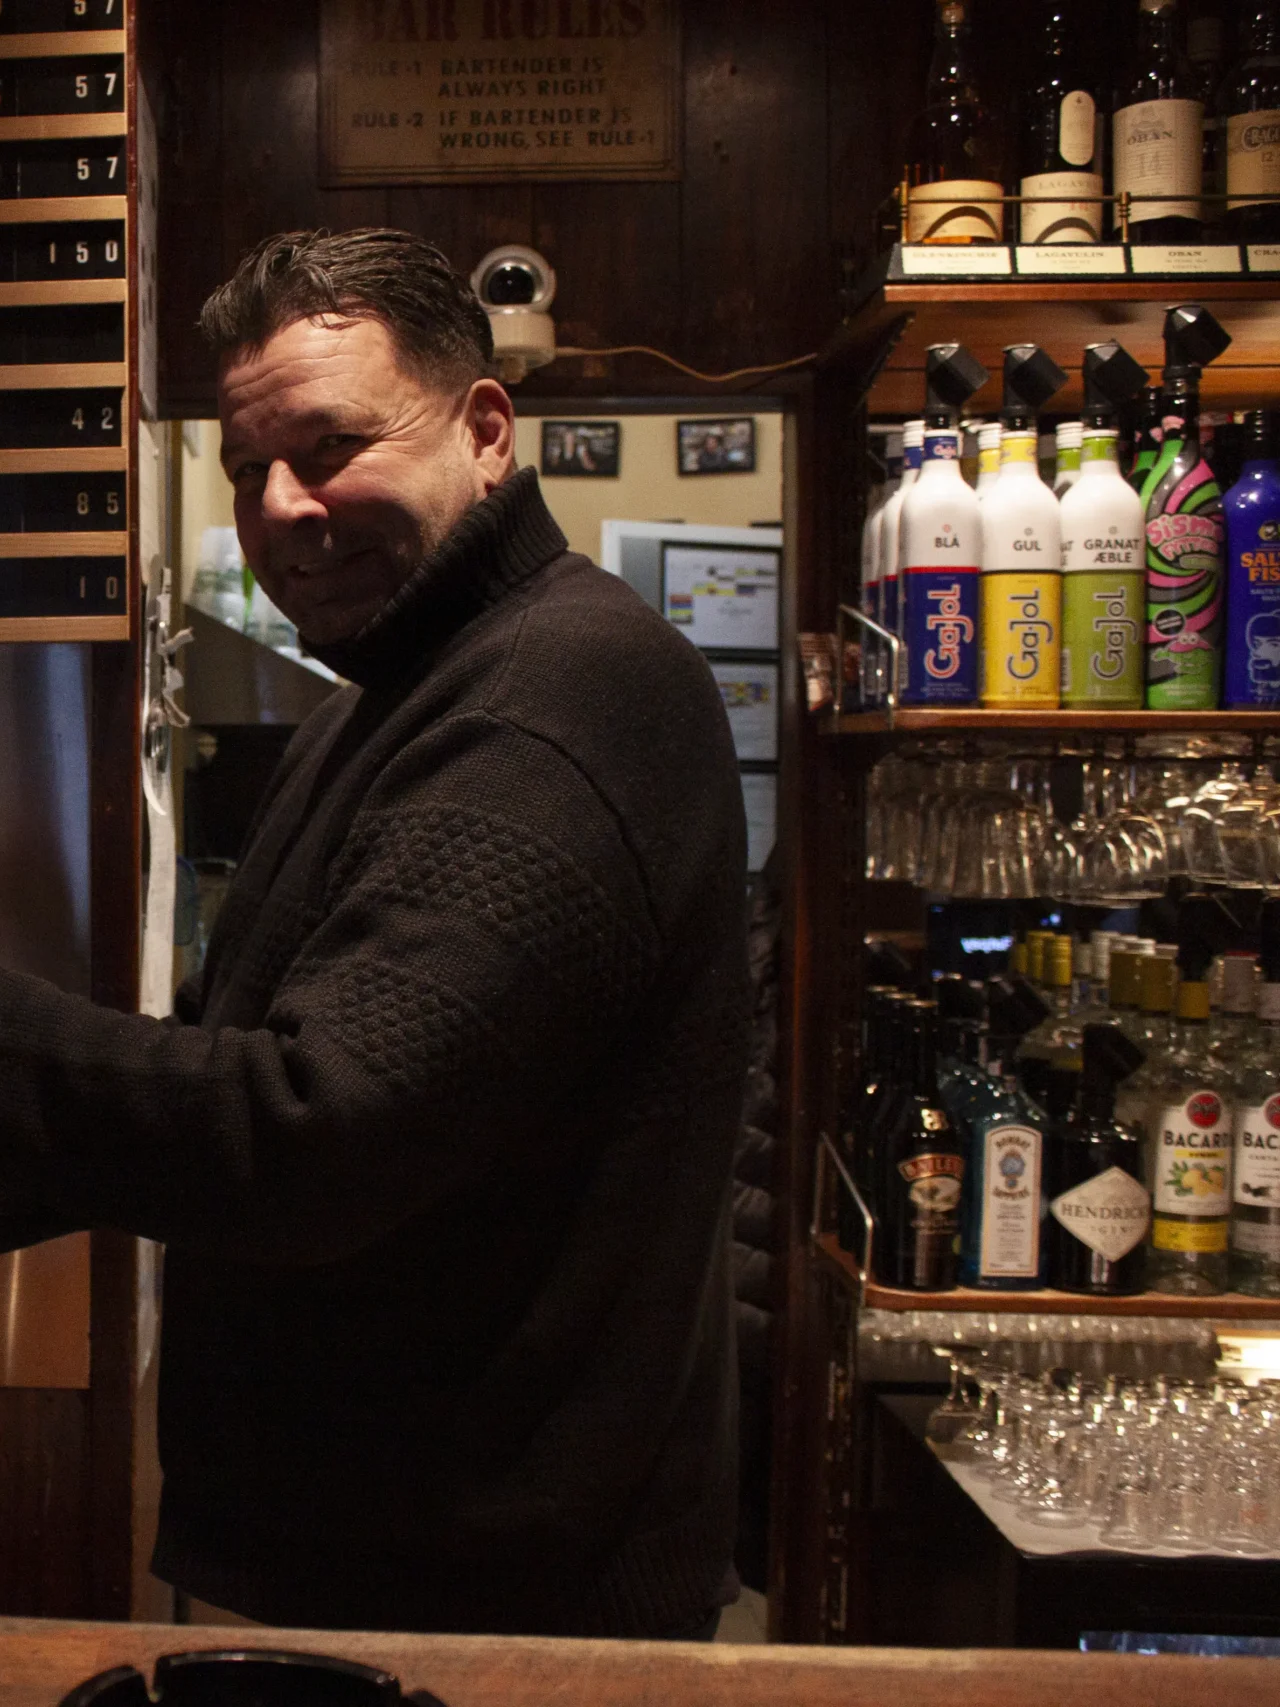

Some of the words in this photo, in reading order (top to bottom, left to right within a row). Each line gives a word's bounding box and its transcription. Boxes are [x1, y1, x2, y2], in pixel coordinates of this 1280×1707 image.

[441, 58, 572, 76] BARTENDER
[583, 57, 604, 73] IS
[438, 79, 527, 98] ALWAYS
[537, 78, 605, 95] RIGHT
[439, 110, 457, 126] IF
[470, 108, 601, 126] BARTENDER
[536, 131, 572, 147] SEE
[1127, 130, 1173, 146] OBAN
[1035, 251, 1105, 259] LAGAVULIN
[934, 534, 960, 548] BLÅ
[1013, 540, 1042, 551] GUL
[1084, 539, 1140, 550] GRANAT
[1093, 552, 1132, 563] ÆBLE
